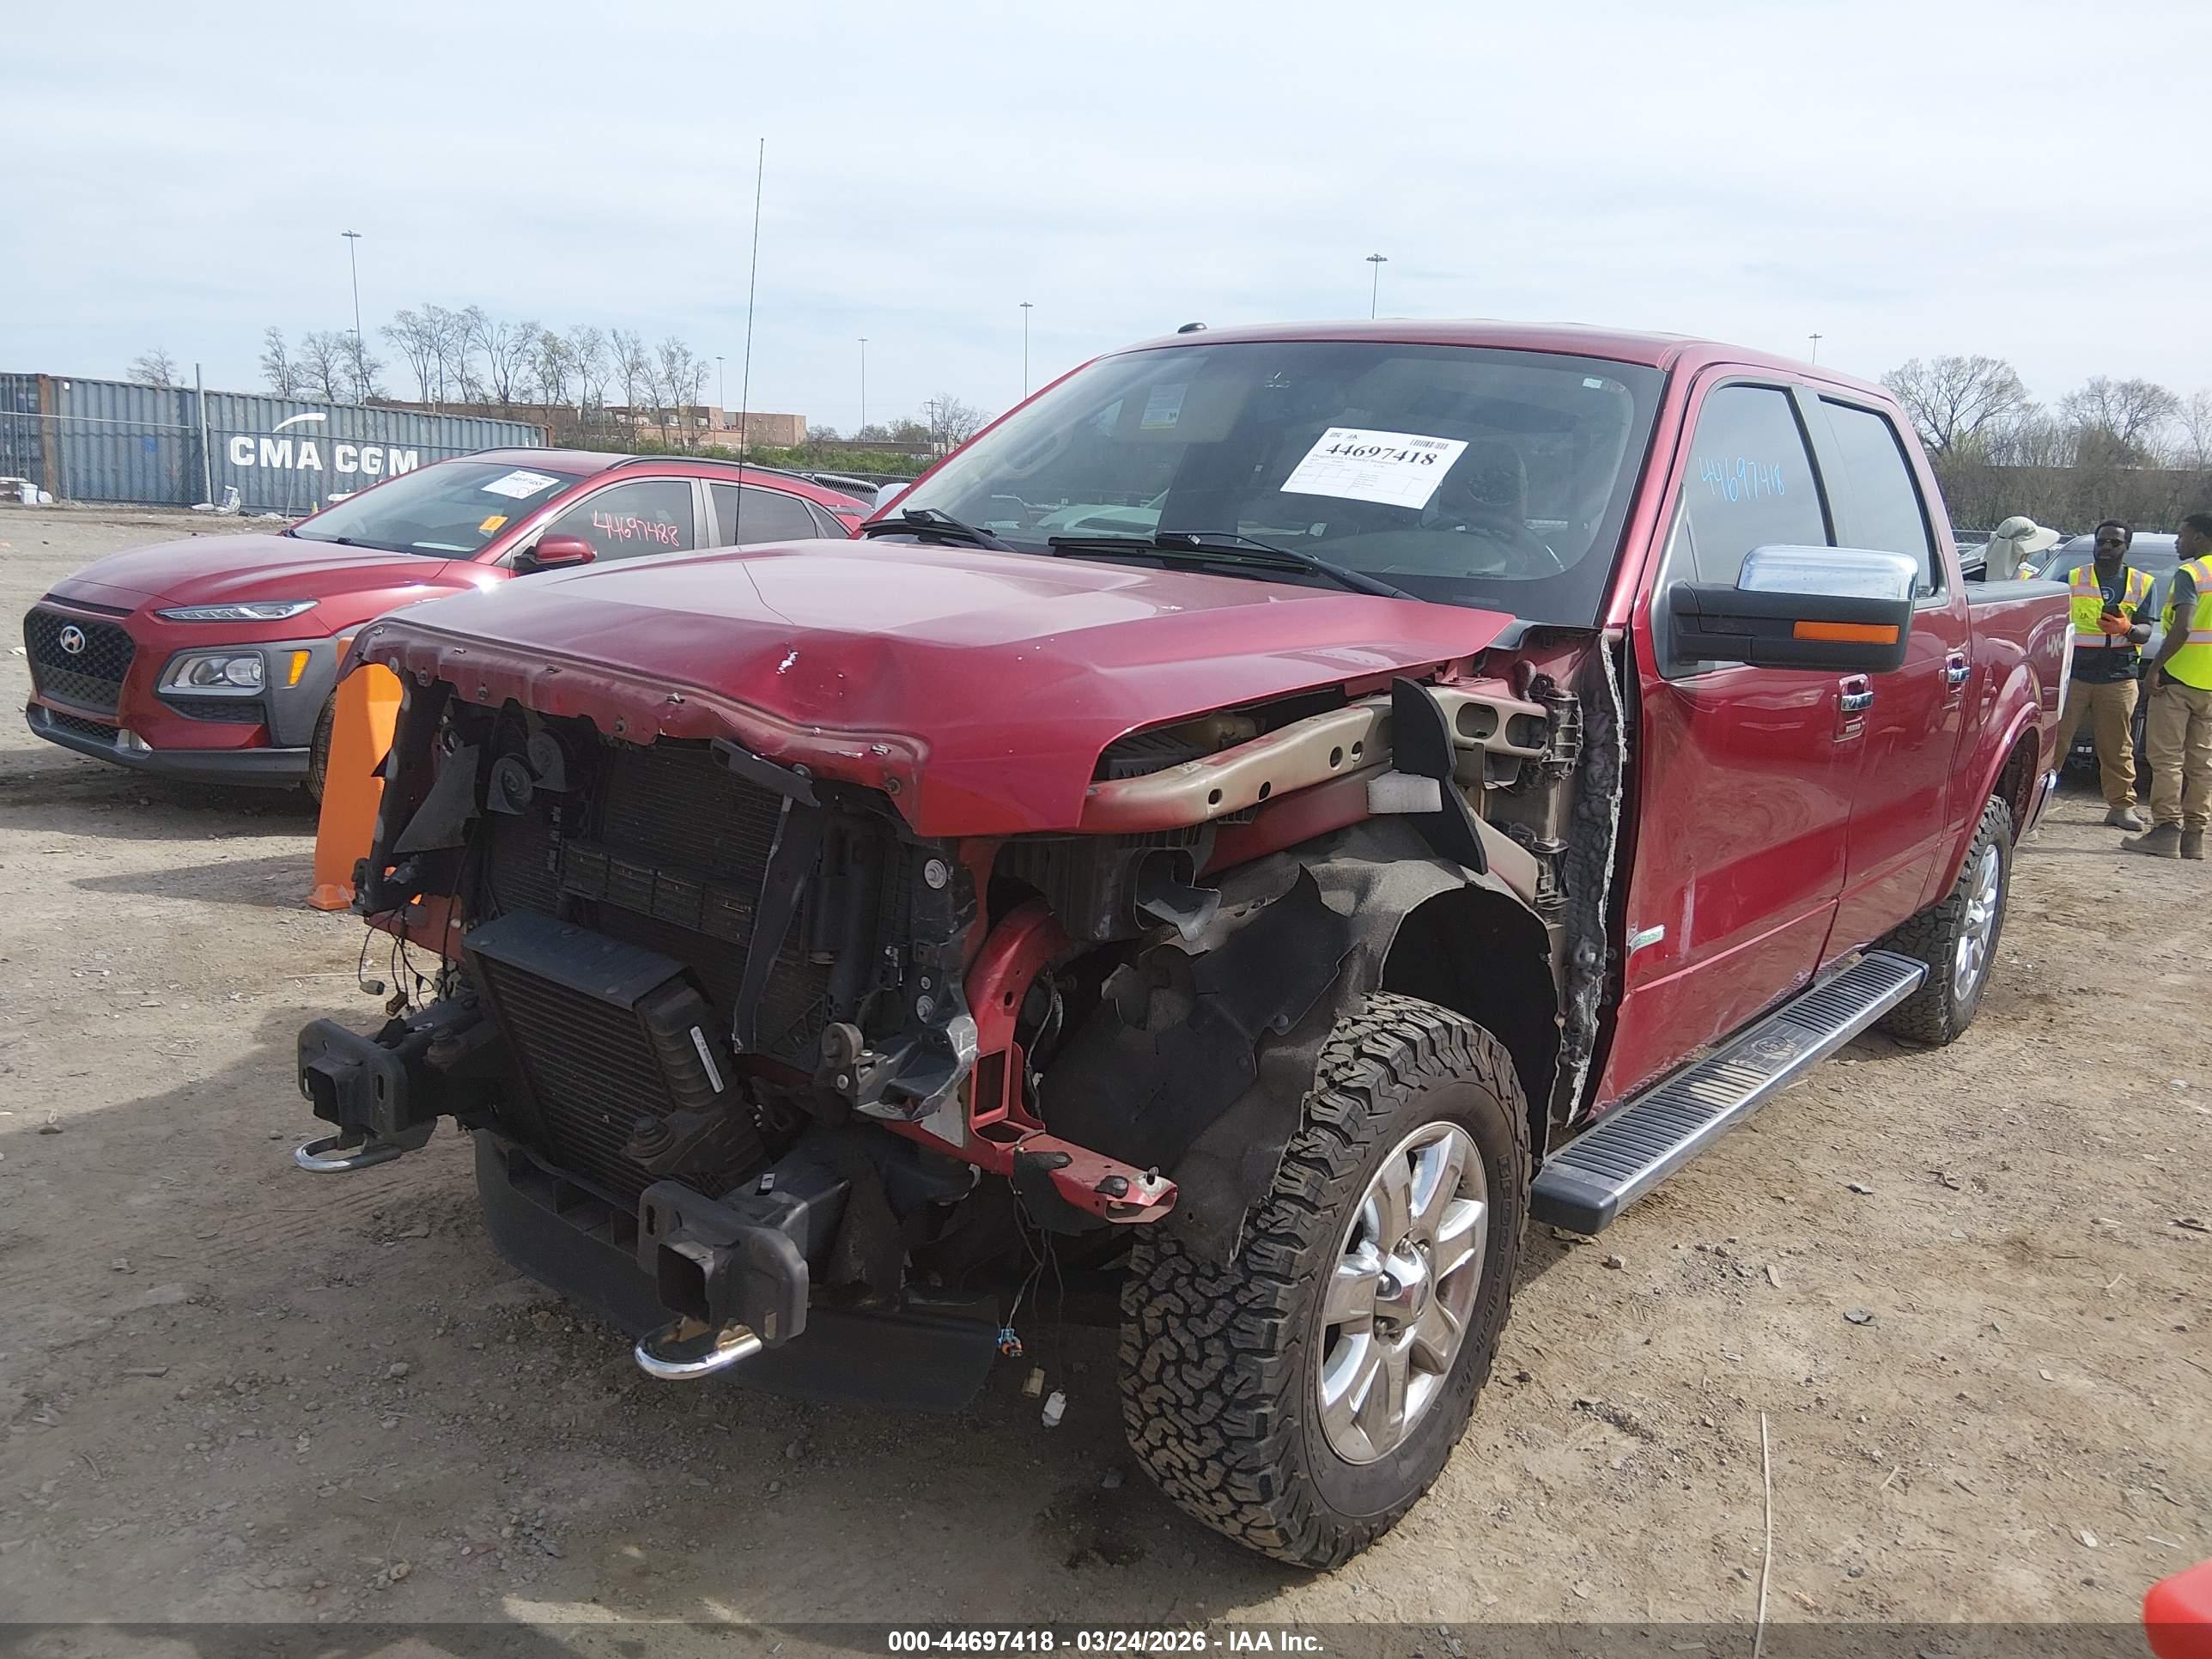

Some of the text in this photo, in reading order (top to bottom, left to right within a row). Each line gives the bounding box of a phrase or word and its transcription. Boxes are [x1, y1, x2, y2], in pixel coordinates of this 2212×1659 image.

[230, 435, 418, 476] CMA CGM
[1326, 443, 1437, 465] 44697418
[1698, 456, 1785, 502] 44697418
[592, 509, 680, 547] 44697488
